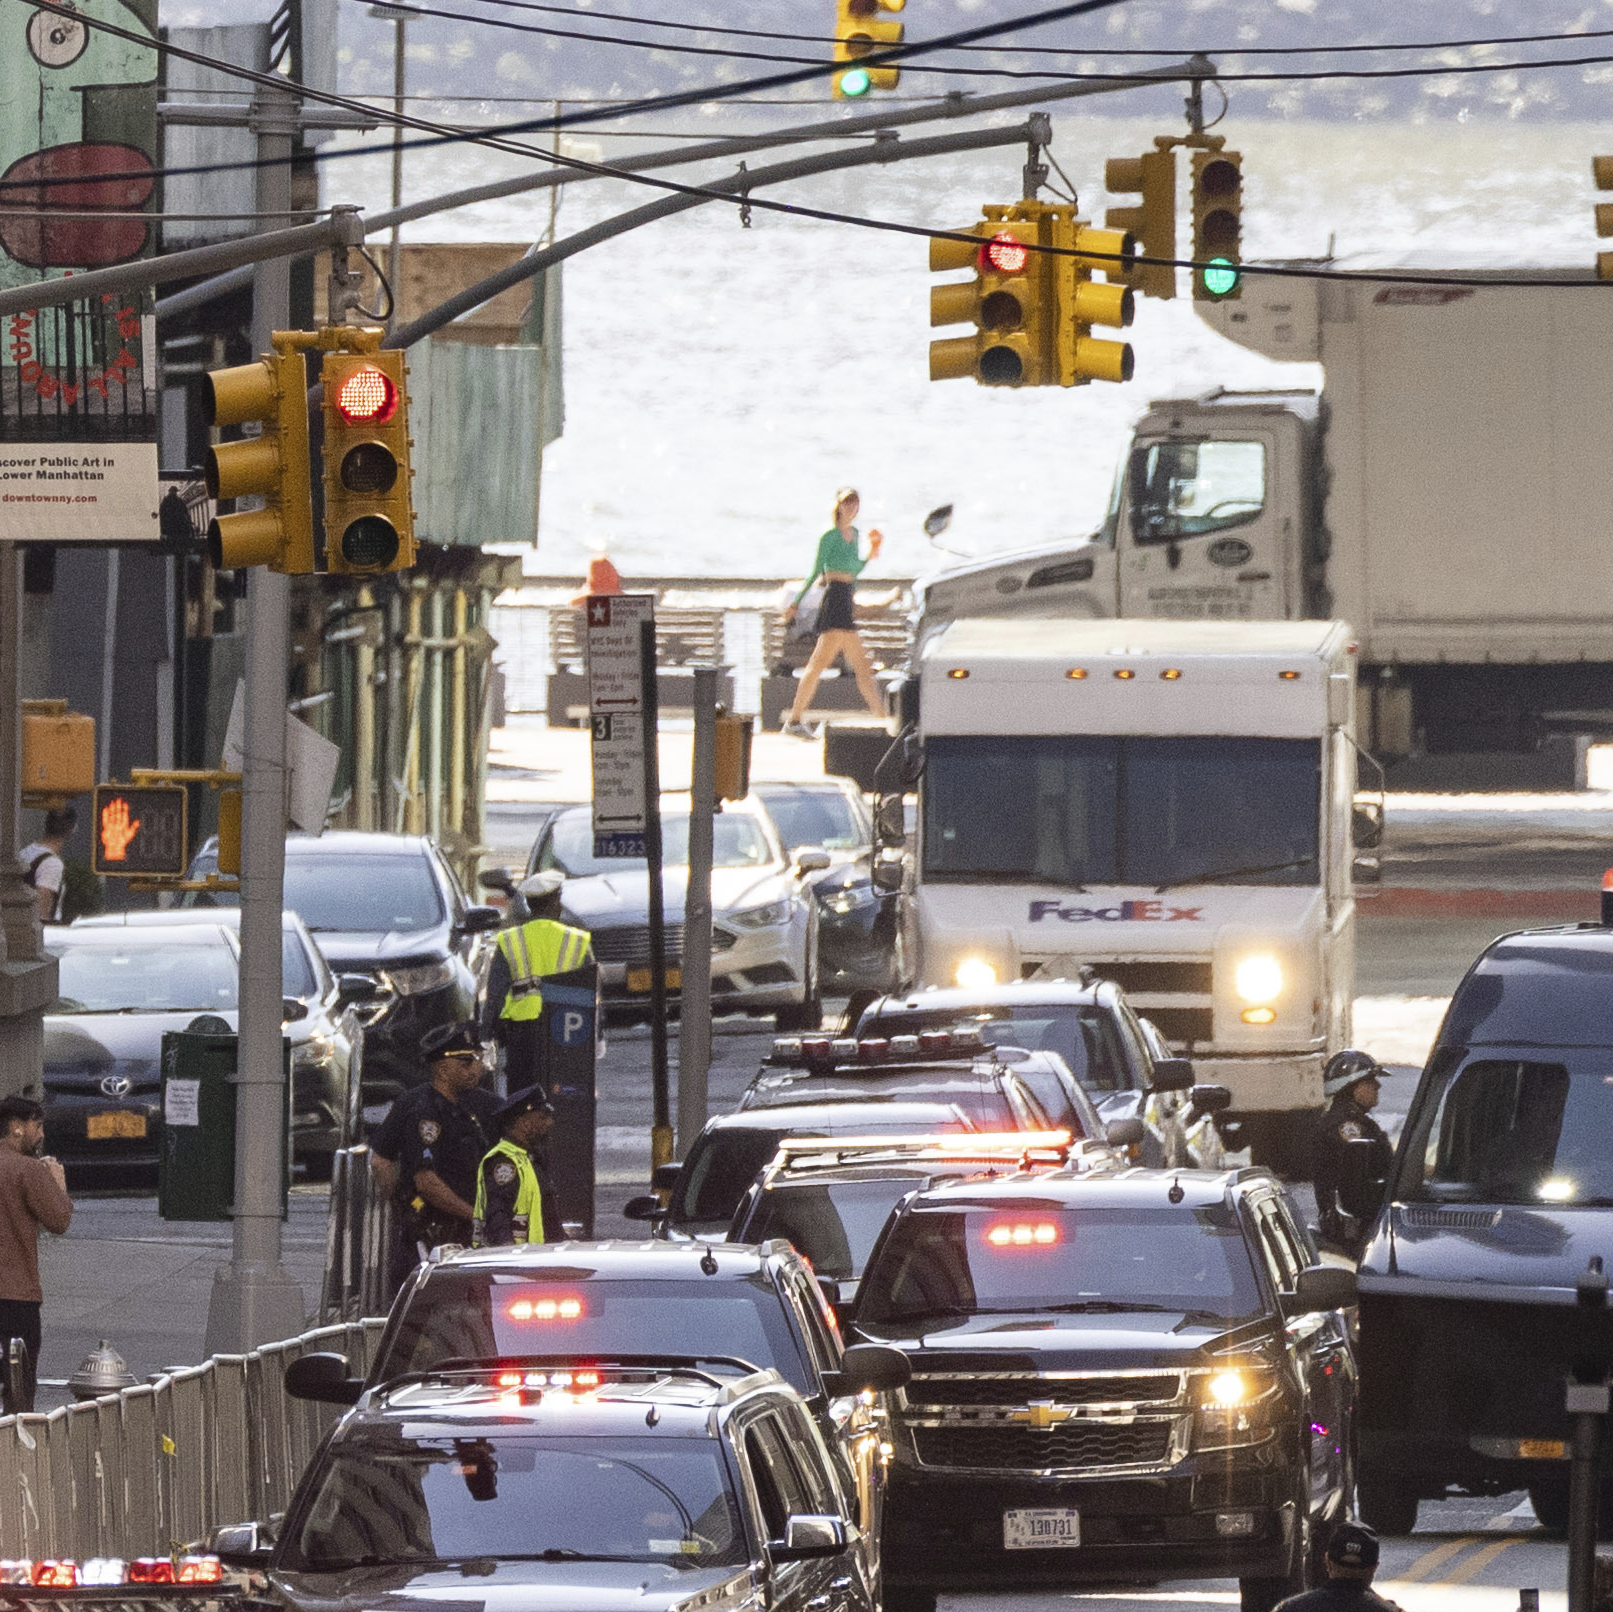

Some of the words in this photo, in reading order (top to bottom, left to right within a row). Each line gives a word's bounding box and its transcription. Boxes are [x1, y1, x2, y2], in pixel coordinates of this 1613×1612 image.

[39, 456, 79, 468] Public
[81, 456, 100, 468] Art
[102, 456, 115, 468] in
[35, 470, 105, 481] Manhattan
[1, 493, 98, 506] downtownny.com
[594, 717, 607, 738] 3
[1028, 899, 1204, 923] FedEx
[563, 1012, 584, 1043] P
